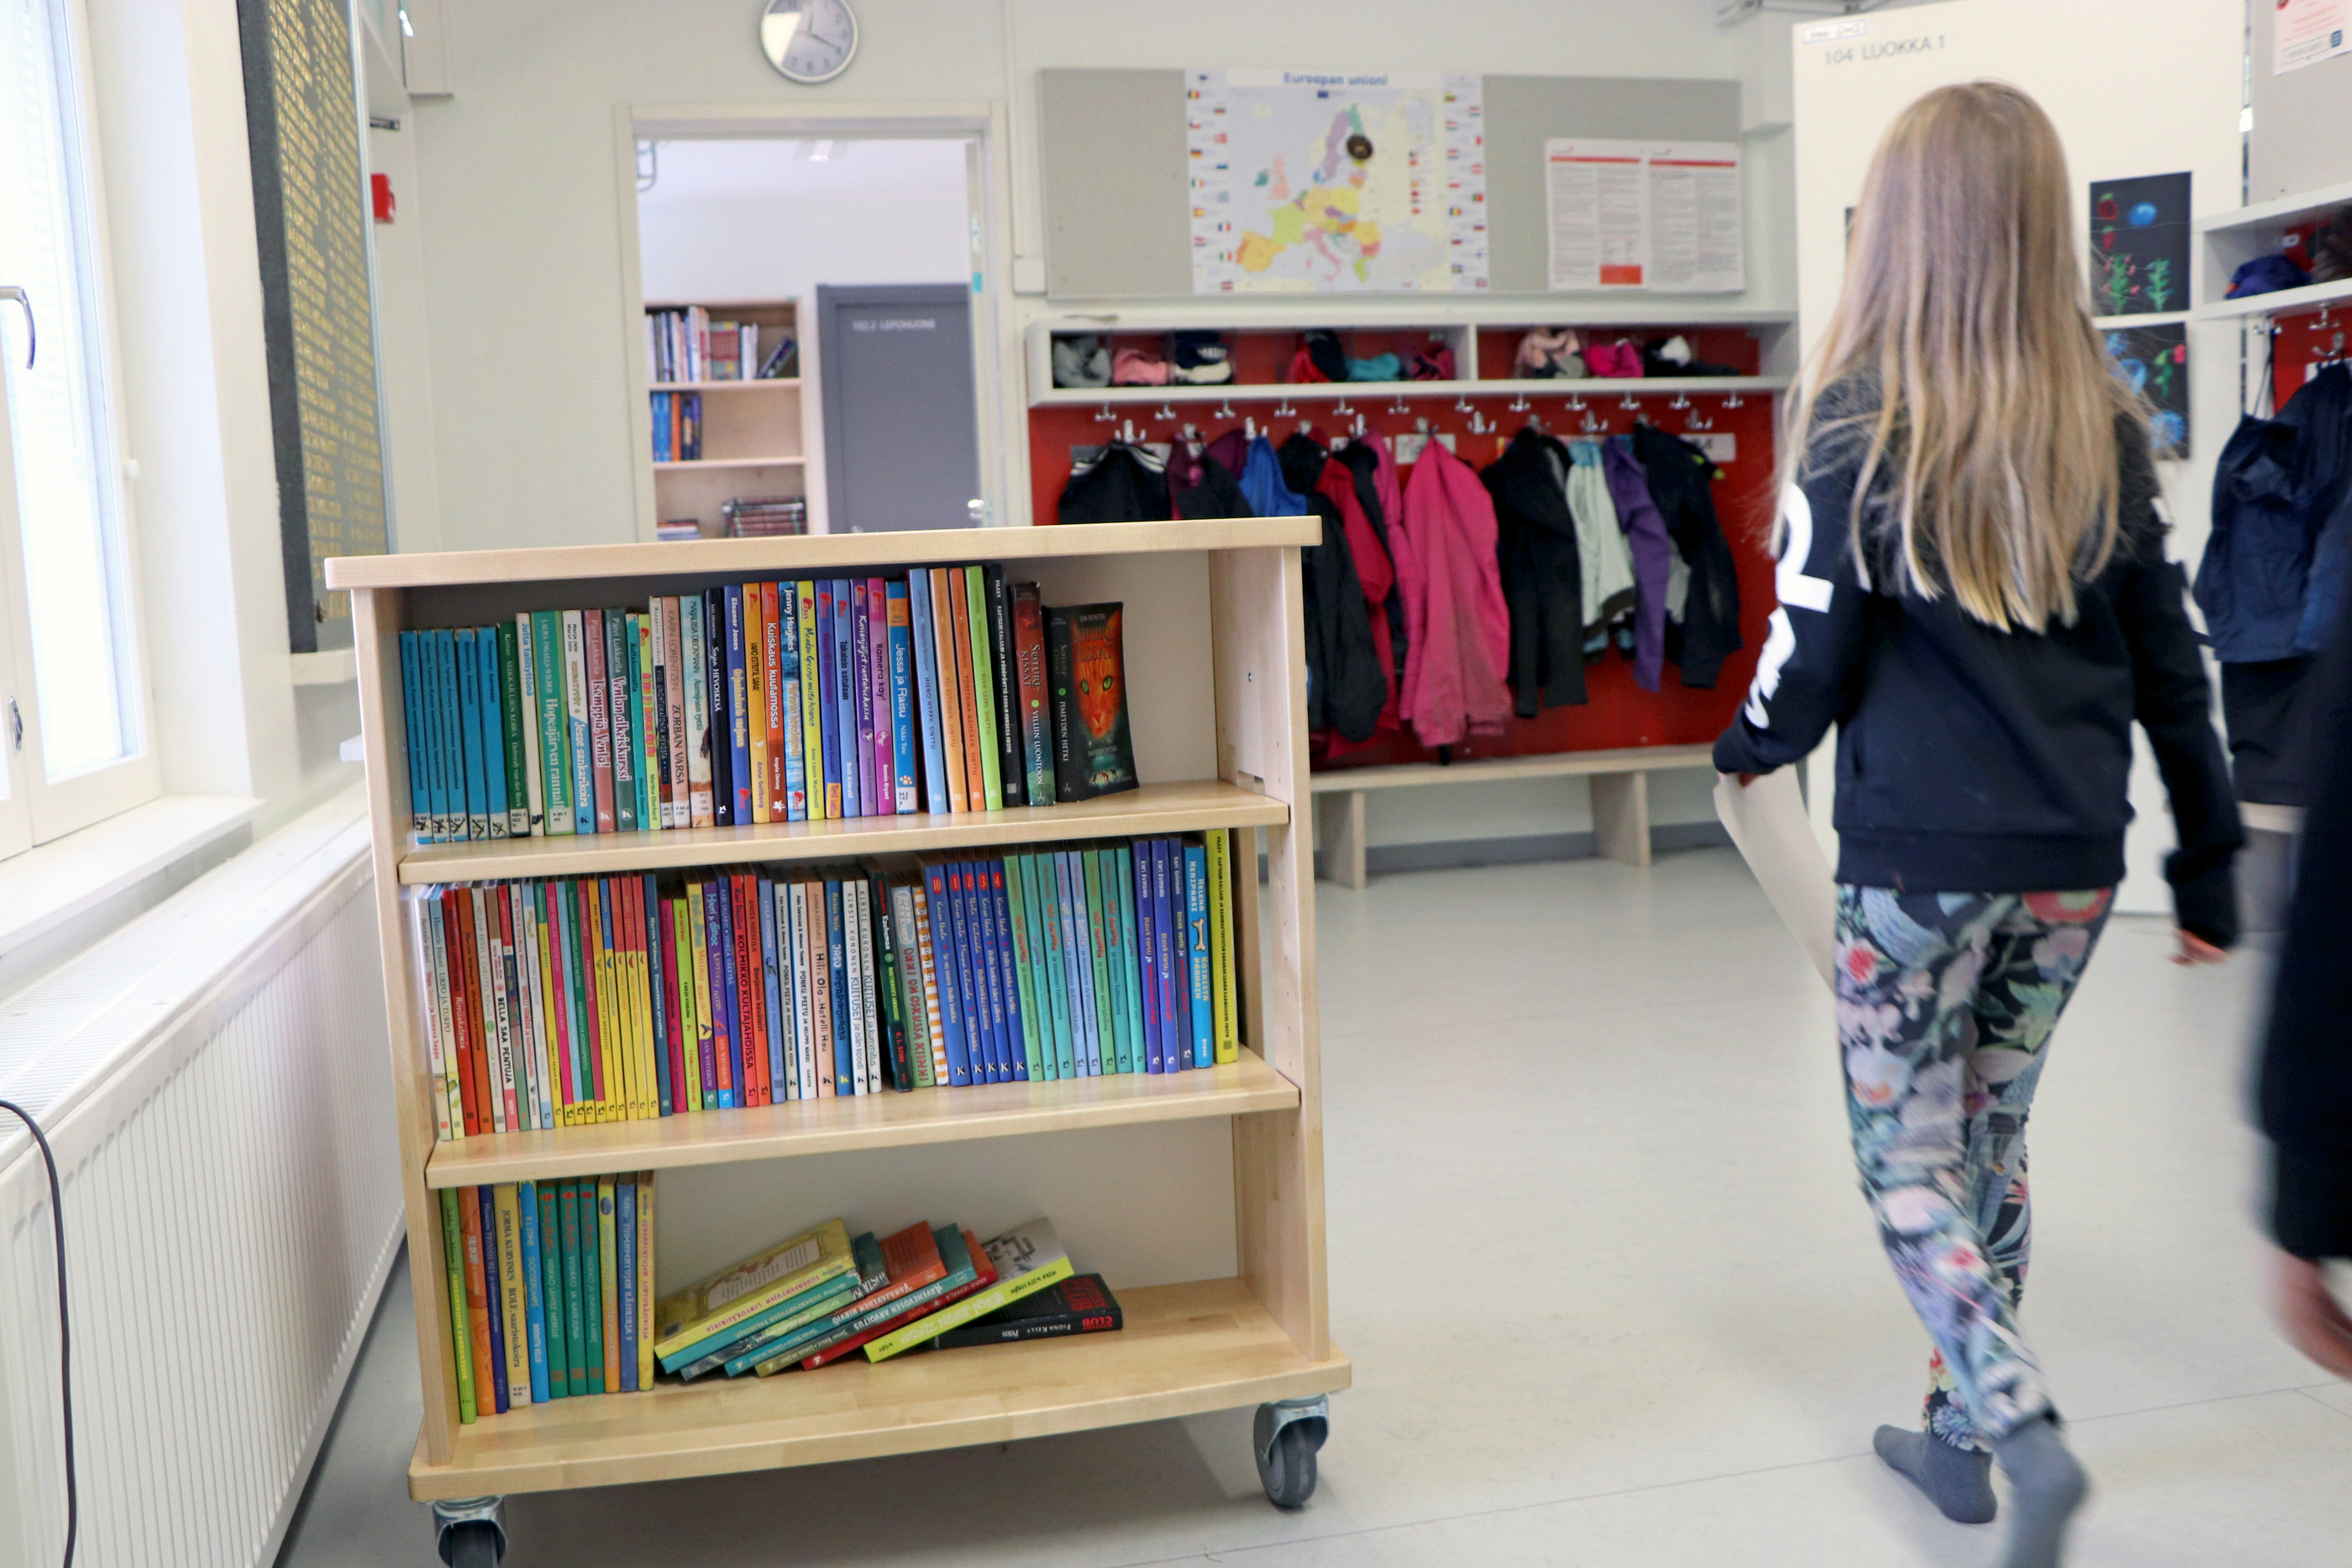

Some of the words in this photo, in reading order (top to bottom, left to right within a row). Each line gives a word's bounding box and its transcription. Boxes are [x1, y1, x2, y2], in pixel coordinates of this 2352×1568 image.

[1824, 48, 1853, 65] 104
[1861, 37, 1932, 60] LUOKKA
[1938, 34, 1945, 49] 1
[1284, 72, 1343, 86] Euroopan
[1349, 74, 1388, 85] unioni
[784, 589, 795, 613] Jenny
[521, 623, 531, 645] Jutta
[667, 610, 677, 636] KARIN
[785, 615, 795, 651] Hughes
[767, 622, 778, 666] Kuiskaus
[804, 627, 814, 654] Meadow
[839, 641, 848, 669] Takaisin
[522, 648, 533, 696] tallityttönä
[669, 639, 680, 690] LORENTZEN
[895, 643, 906, 673] Jessa
[1021, 650, 1032, 687] KISSAT
[507, 660, 515, 712] SEIKKAILUJEN
[611, 676, 627, 713] Venlan
[713, 669, 722, 711] HEVOSKESÄ
[806, 681, 814, 700] musta
[841, 671, 849, 700] satulaan
[895, 675, 906, 685] ja
[657, 684, 666, 732] UNOHTUMATONTA
[769, 669, 779, 728] kuutamossa
[897, 687, 908, 717] Raisu
[574, 721, 586, 747] Jesse
[672, 705, 681, 748] ZORBAN
[964, 675, 973, 712] TORSTAINA
[969, 752, 978, 775] SINTTU
[1032, 711, 1041, 739] VILLIIN
[1058, 701, 1068, 738] PIMEYDEN
[594, 733, 610, 767] Venla!
[613, 715, 632, 781] alkeiskurssi
[659, 734, 668, 759] HEVOSTA
[1061, 740, 1069, 762] HETKI
[576, 748, 590, 807] sankarikoira
[674, 752, 684, 784] VARSA
[1033, 741, 1044, 784] LUONTOON
[756, 780, 764, 808] Sellberg
[433, 916, 444, 945] Hannele
[881, 915, 891, 950] Kauhumaa
[437, 947, 446, 968] Huovi
[737, 935, 748, 988] KOLMIKKO
[832, 944, 842, 968] JASU
[849, 931, 858, 973] KURONEN
[862, 927, 871, 972] KURONEN
[903, 948, 915, 976] ONNI
[438, 973, 449, 994] URPO
[753, 968, 761, 1000] Benjamin
[816, 978, 827, 995] Ola
[909, 979, 917, 994] ON
[439, 995, 449, 1005] JA
[497, 997, 507, 1023] BELLA
[850, 977, 862, 1021] KUITUSET
[442, 1007, 451, 1033] TURPO
[739, 989, 753, 1069] KULTAJAHDISSA
[755, 1002, 764, 1031] kesäleiri
[818, 1003, 827, 1032] Hotelli
[864, 974, 874, 1020] KUITUSET
[869, 1029, 878, 1066] kummitus
[910, 995, 922, 1040] OSKUSSA
[500, 1026, 508, 1044] SAA
[821, 1034, 829, 1051] Hau
[855, 1032, 864, 1048] isän
[502, 1046, 512, 1083] PENTUJA
[857, 1049, 865, 1069] koodi
[915, 1042, 928, 1081] KIINNI
[501, 1209, 512, 1238] JORMA
[504, 1240, 517, 1282] KURVINEN
[623, 1223, 633, 1289] SUDENPENTUJEN
[642, 1219, 650, 1277] SUDENPENTUJEN
[547, 1257, 557, 1287] VIISIKKO
[569, 1256, 578, 1287] VIISIKKO
[586, 1255, 596, 1283] VIISIKKO
[528, 1256, 539, 1308] GOOSEBUMPS
[534, 1348, 543, 1363] KELLO
[570, 1291, 578, 1299] JA
[892, 1282, 943, 1315] AAVEHEVOSEN
[549, 1312, 559, 1339] MERELLE
[570, 1302, 580, 1340] AAVEJUNA
[624, 1292, 634, 1335] KÄSIKIRJA
[642, 1281, 650, 1340] LINTUKÄSIKIRJA
[853, 1307, 891, 1330] ARVOITUS
[1082, 1316, 1114, 1324] CLUB
[509, 1313, 522, 1367] saaristokoira
[590, 1322, 598, 1343] AARRE
[1001, 1329, 1019, 1338] Petos
